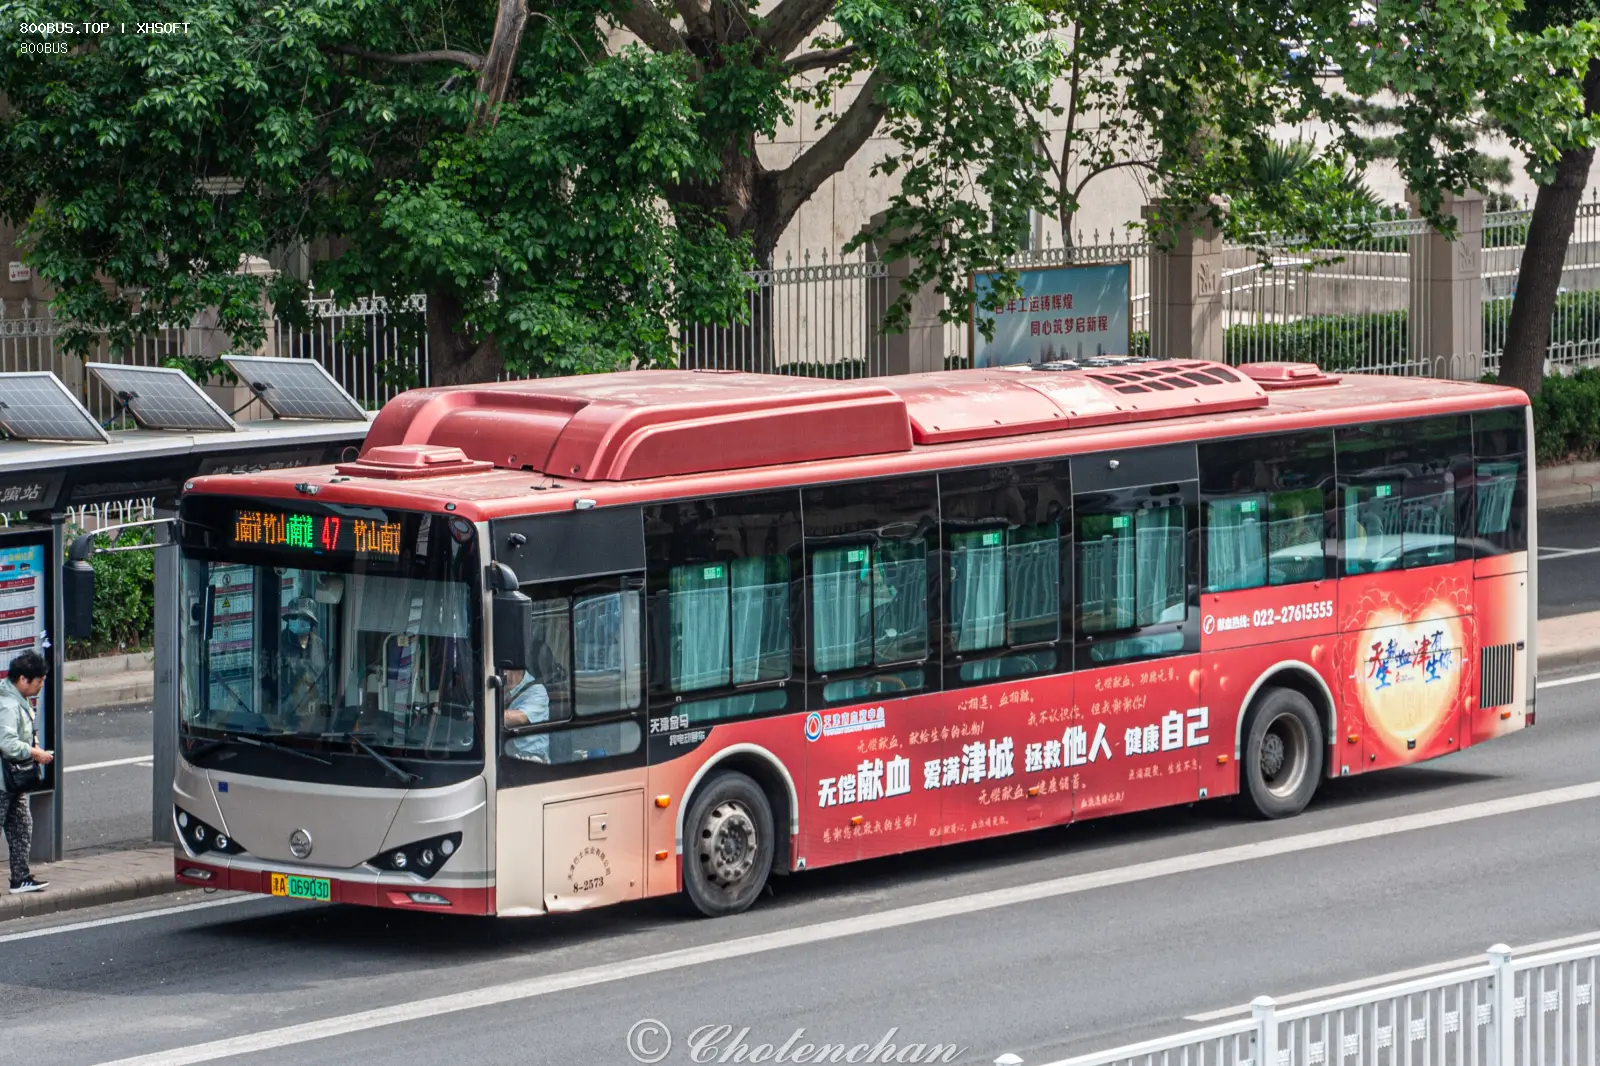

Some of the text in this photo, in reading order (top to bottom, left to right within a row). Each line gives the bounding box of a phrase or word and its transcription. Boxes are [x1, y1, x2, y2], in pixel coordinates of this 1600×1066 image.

[994, 293, 1073, 315] 百年工运铸辉煌
[1030, 315, 1108, 337] 同心筑梦启新程
[0, 483, 43, 503] 寓站
[321, 516, 341, 550] 47
[1253, 600, 1334, 627] 022-27615555
[650, 714, 689, 733] 天津金马
[817, 706, 1210, 808] 无偿献血 爱满津城 拯救他人 健康自己
[573, 876, 604, 894] 8-2573
